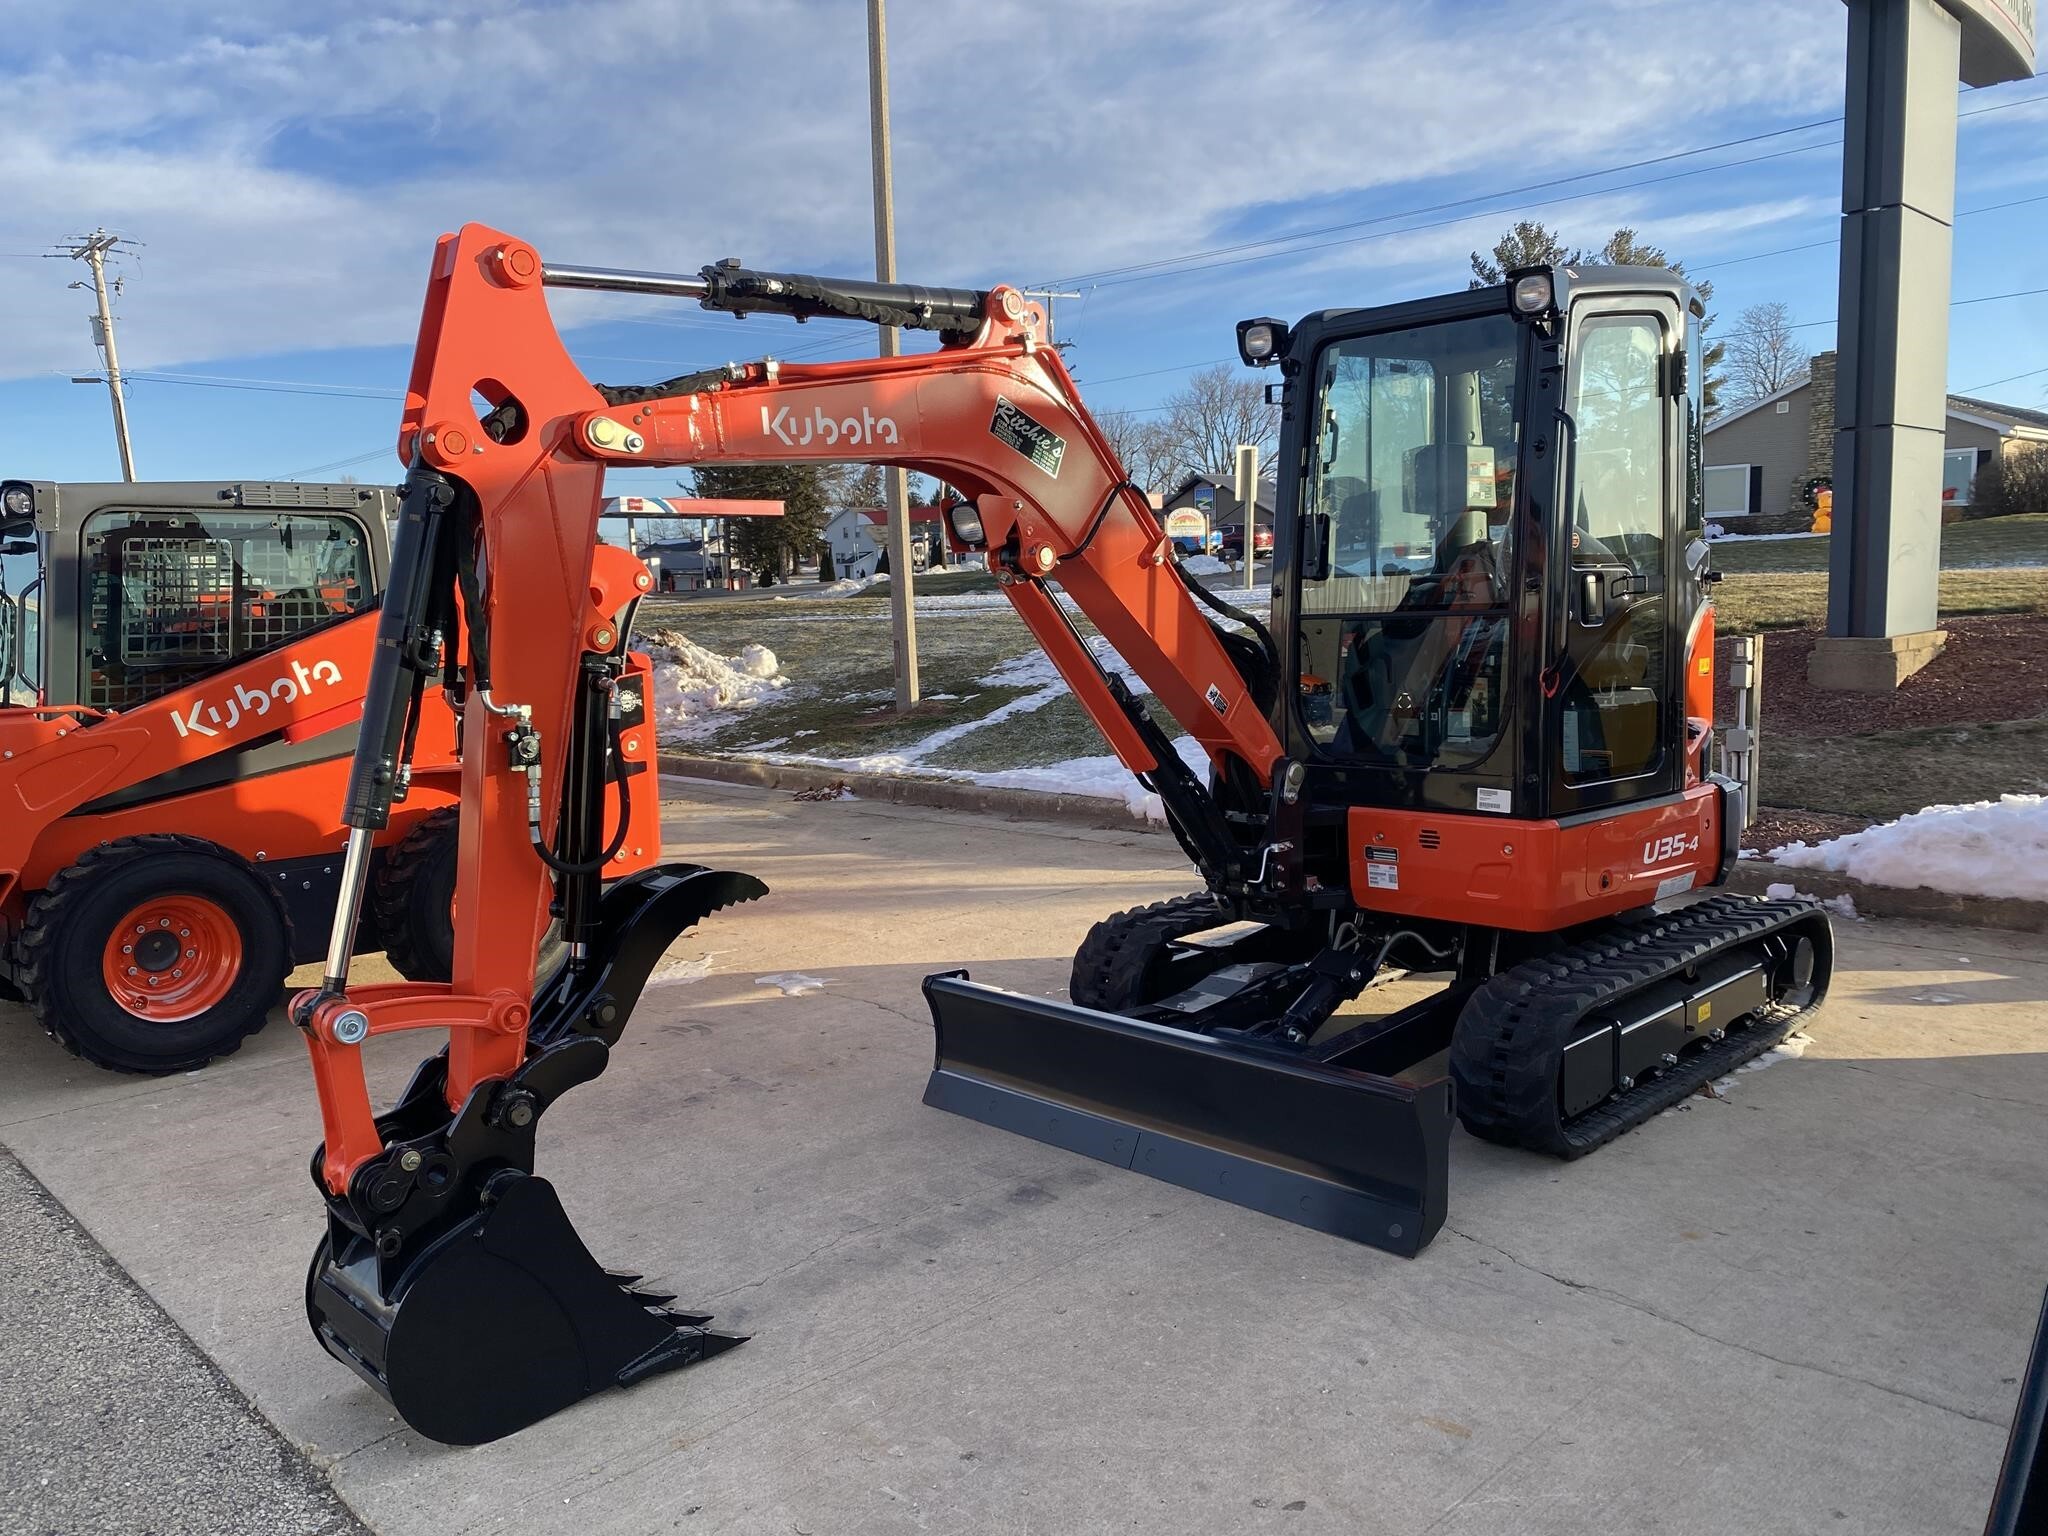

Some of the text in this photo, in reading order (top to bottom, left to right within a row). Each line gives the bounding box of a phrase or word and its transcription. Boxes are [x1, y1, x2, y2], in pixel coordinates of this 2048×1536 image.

[761, 406, 899, 446] Kubota
[996, 399, 1062, 458] Ritchie's
[170, 660, 343, 738] Kubota
[1643, 832, 1699, 865] U35-4
